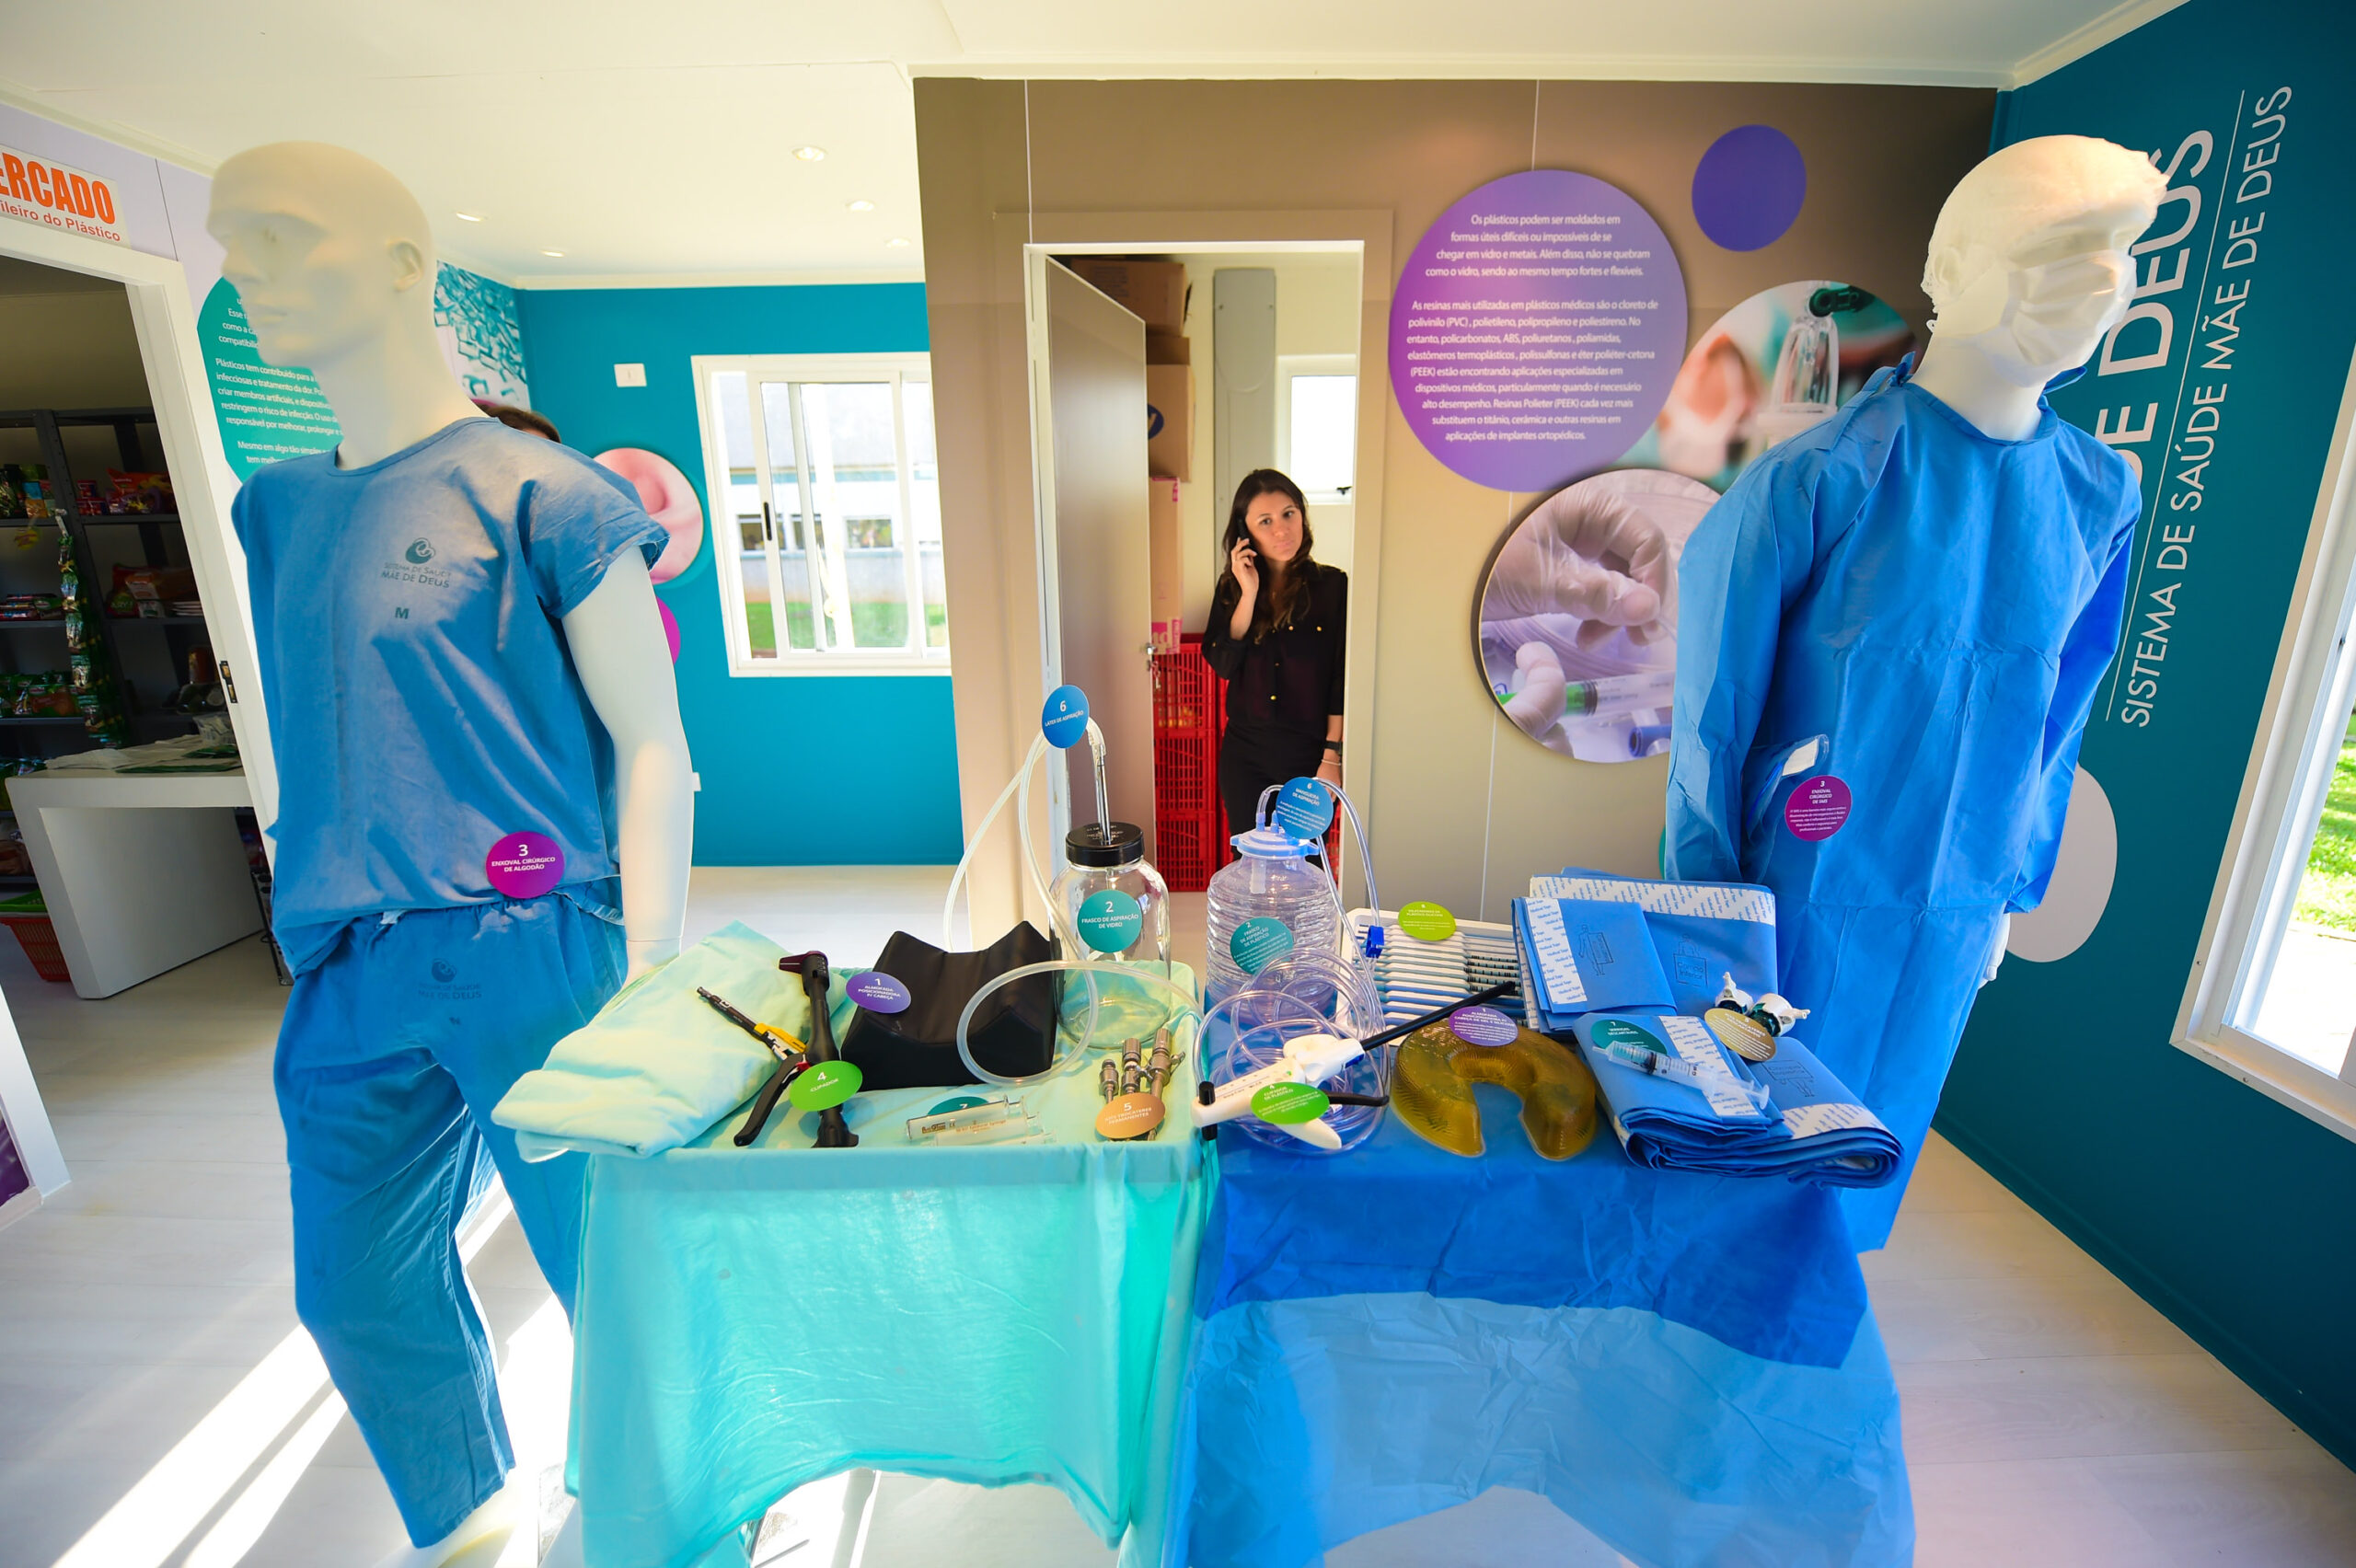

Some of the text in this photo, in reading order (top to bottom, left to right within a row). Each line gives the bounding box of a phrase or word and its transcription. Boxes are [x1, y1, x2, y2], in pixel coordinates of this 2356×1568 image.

[1471, 214, 1621, 226] Os plásticos podem ser moldados em
[43, 213, 62, 226] do
[65, 217, 121, 241] Plástico
[1451, 231, 1479, 242] formas
[1481, 232, 1500, 242] úteis
[1530, 234, 1542, 242] ou
[1590, 232, 1601, 242] de
[1602, 234, 1612, 242] se
[1437, 248, 1464, 261] chegar
[1466, 250, 1480, 259] em
[1481, 248, 1502, 259] vidro
[1540, 248, 1561, 259] Além
[1586, 249, 1601, 259] não
[1613, 248, 1650, 260] quebram
[2098, 130, 2213, 376] DEUS
[1426, 268, 1449, 276] como
[1482, 266, 1506, 276] sendo
[1507, 268, 1518, 276] ao
[1519, 268, 1550, 276] mesmo
[1551, 267, 1578, 278] tempo
[1579, 265, 1602, 276] fortes
[1412, 299, 1658, 312] As resinas mais utilizadas em plásticos médicos são cloreto de
[227, 308, 244, 319] Esse
[223, 322, 242, 332] como
[1629, 317, 1641, 326] No
[1437, 367, 1458, 376] estão
[1460, 366, 1510, 376] encontrando
[1511, 366, 1552, 378] aplicações
[1553, 365, 1608, 377] especializadas
[1415, 384, 1461, 394] dispositivos
[1498, 383, 1561, 394] particularmente
[1562, 383, 1593, 393] quando
[1600, 382, 1642, 391] necessário
[1422, 399, 1438, 409] alto
[1493, 398, 1521, 409] Resinas
[1580, 398, 1599, 408] cada
[1615, 398, 1634, 408] mais
[2121, 86, 2292, 727] SISTEMA DE SAÚDE MÃE DE DEUS
[1432, 415, 1475, 424] substituem
[1511, 415, 1546, 424] cerâmica
[1554, 416, 1578, 424] outras
[1580, 415, 1606, 424] resinas
[1445, 431, 1485, 442] aplicações
[1487, 431, 1497, 440] de
[1498, 431, 1537, 442] implantes
[402, 572, 415, 582] DE
[418, 574, 450, 588] DEUS
[395, 606, 410, 619] M
[1060, 700, 1067, 712] 6
[518, 844, 528, 857] 3
[1105, 901, 1114, 913] 2
[817, 1071, 826, 1080] 4
[1124, 1101, 1133, 1112] 5
